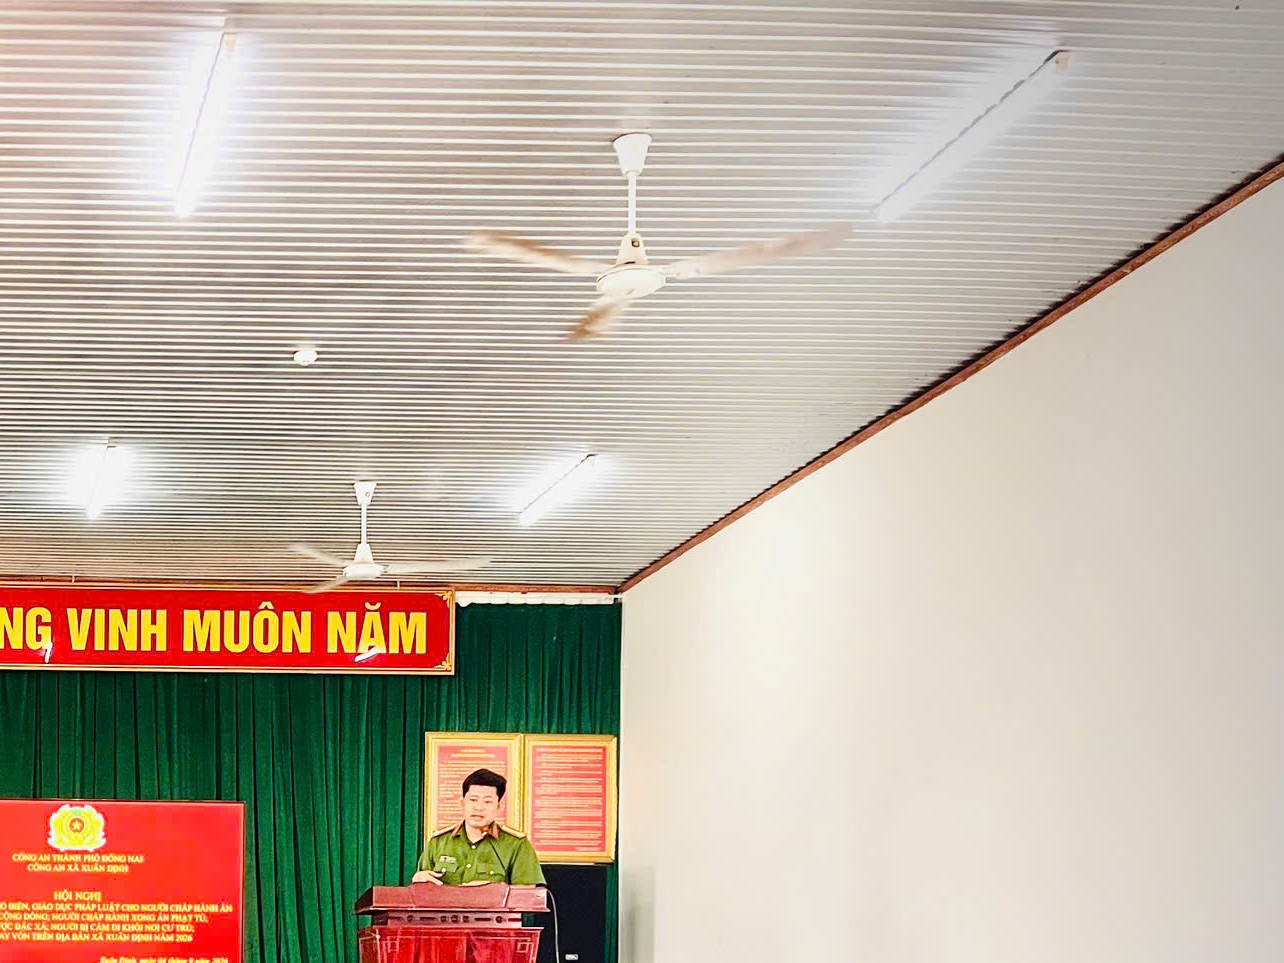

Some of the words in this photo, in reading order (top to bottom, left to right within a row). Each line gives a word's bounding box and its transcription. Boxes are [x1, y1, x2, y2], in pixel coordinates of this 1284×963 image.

[67, 607, 167, 652] VINH
[183, 602, 312, 654] MUÔN
[327, 602, 427, 654] NĂM
[38, 853, 50, 862] AN
[127, 855, 144, 864] NAI
[52, 863, 66, 872] AN
[53, 889, 73, 901] HỘI
[121, 902, 140, 912] CHO
